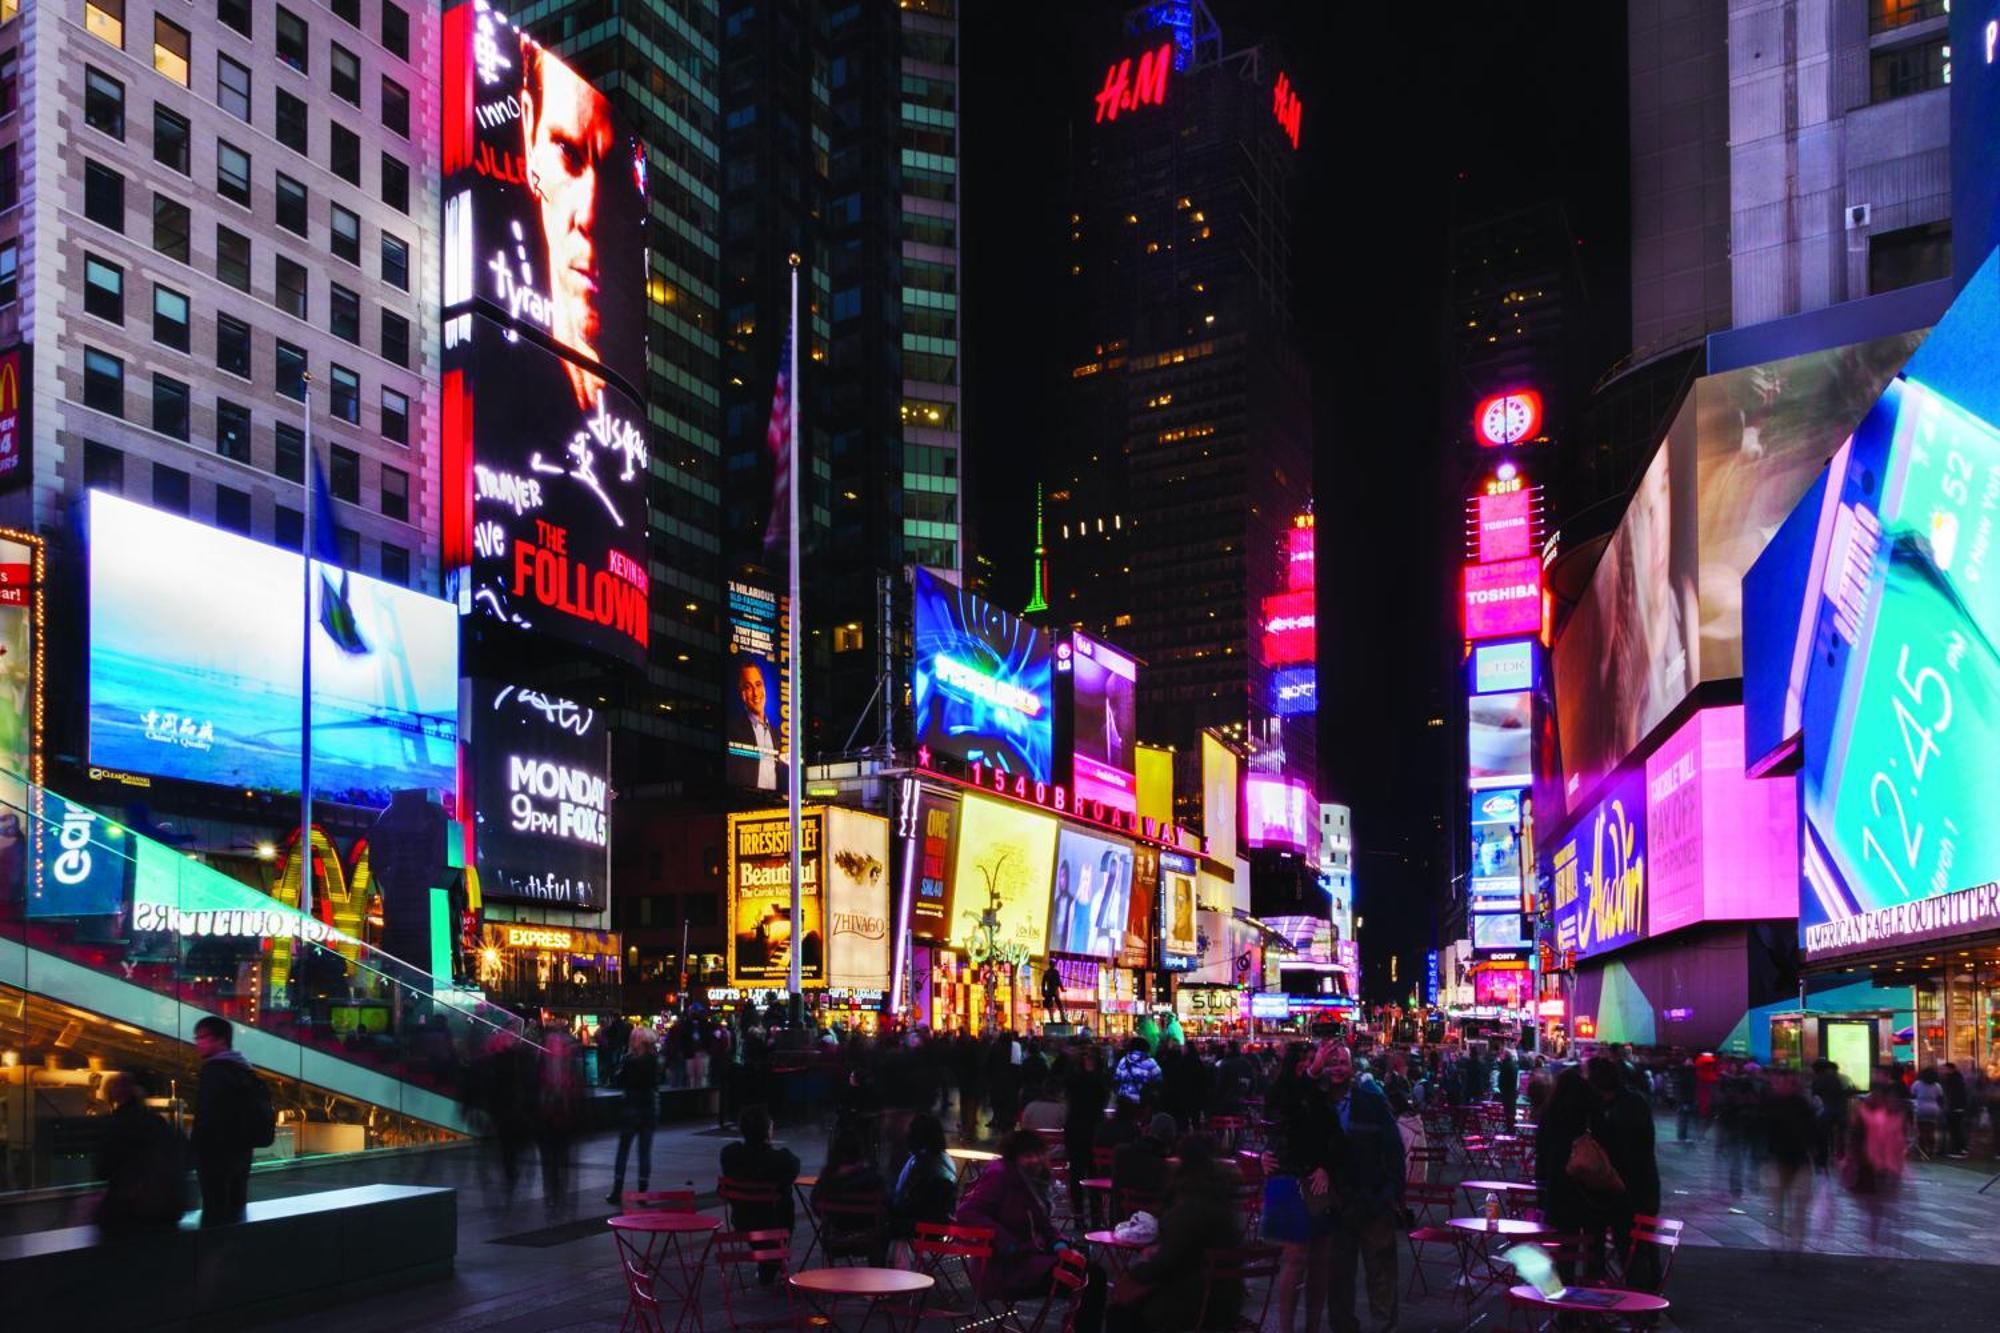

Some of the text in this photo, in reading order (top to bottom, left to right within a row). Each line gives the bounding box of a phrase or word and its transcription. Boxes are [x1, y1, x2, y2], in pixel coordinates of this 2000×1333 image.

[1487, 478, 1521, 496] 2015
[535, 519, 567, 554] THE
[1483, 517, 1526, 532] TOSHIBA
[1466, 583, 1539, 605] TOSHIBA
[1862, 644, 1953, 897] 12:45
[510, 756, 607, 811] MONDAY
[740, 858, 816, 887] Beautiul
[832, 912, 884, 936] ZHIVAGO
[1865, 905, 1905, 940] EAGLE
[509, 928, 571, 948] EXPRESS
[708, 988, 740, 1000] GIFTS
